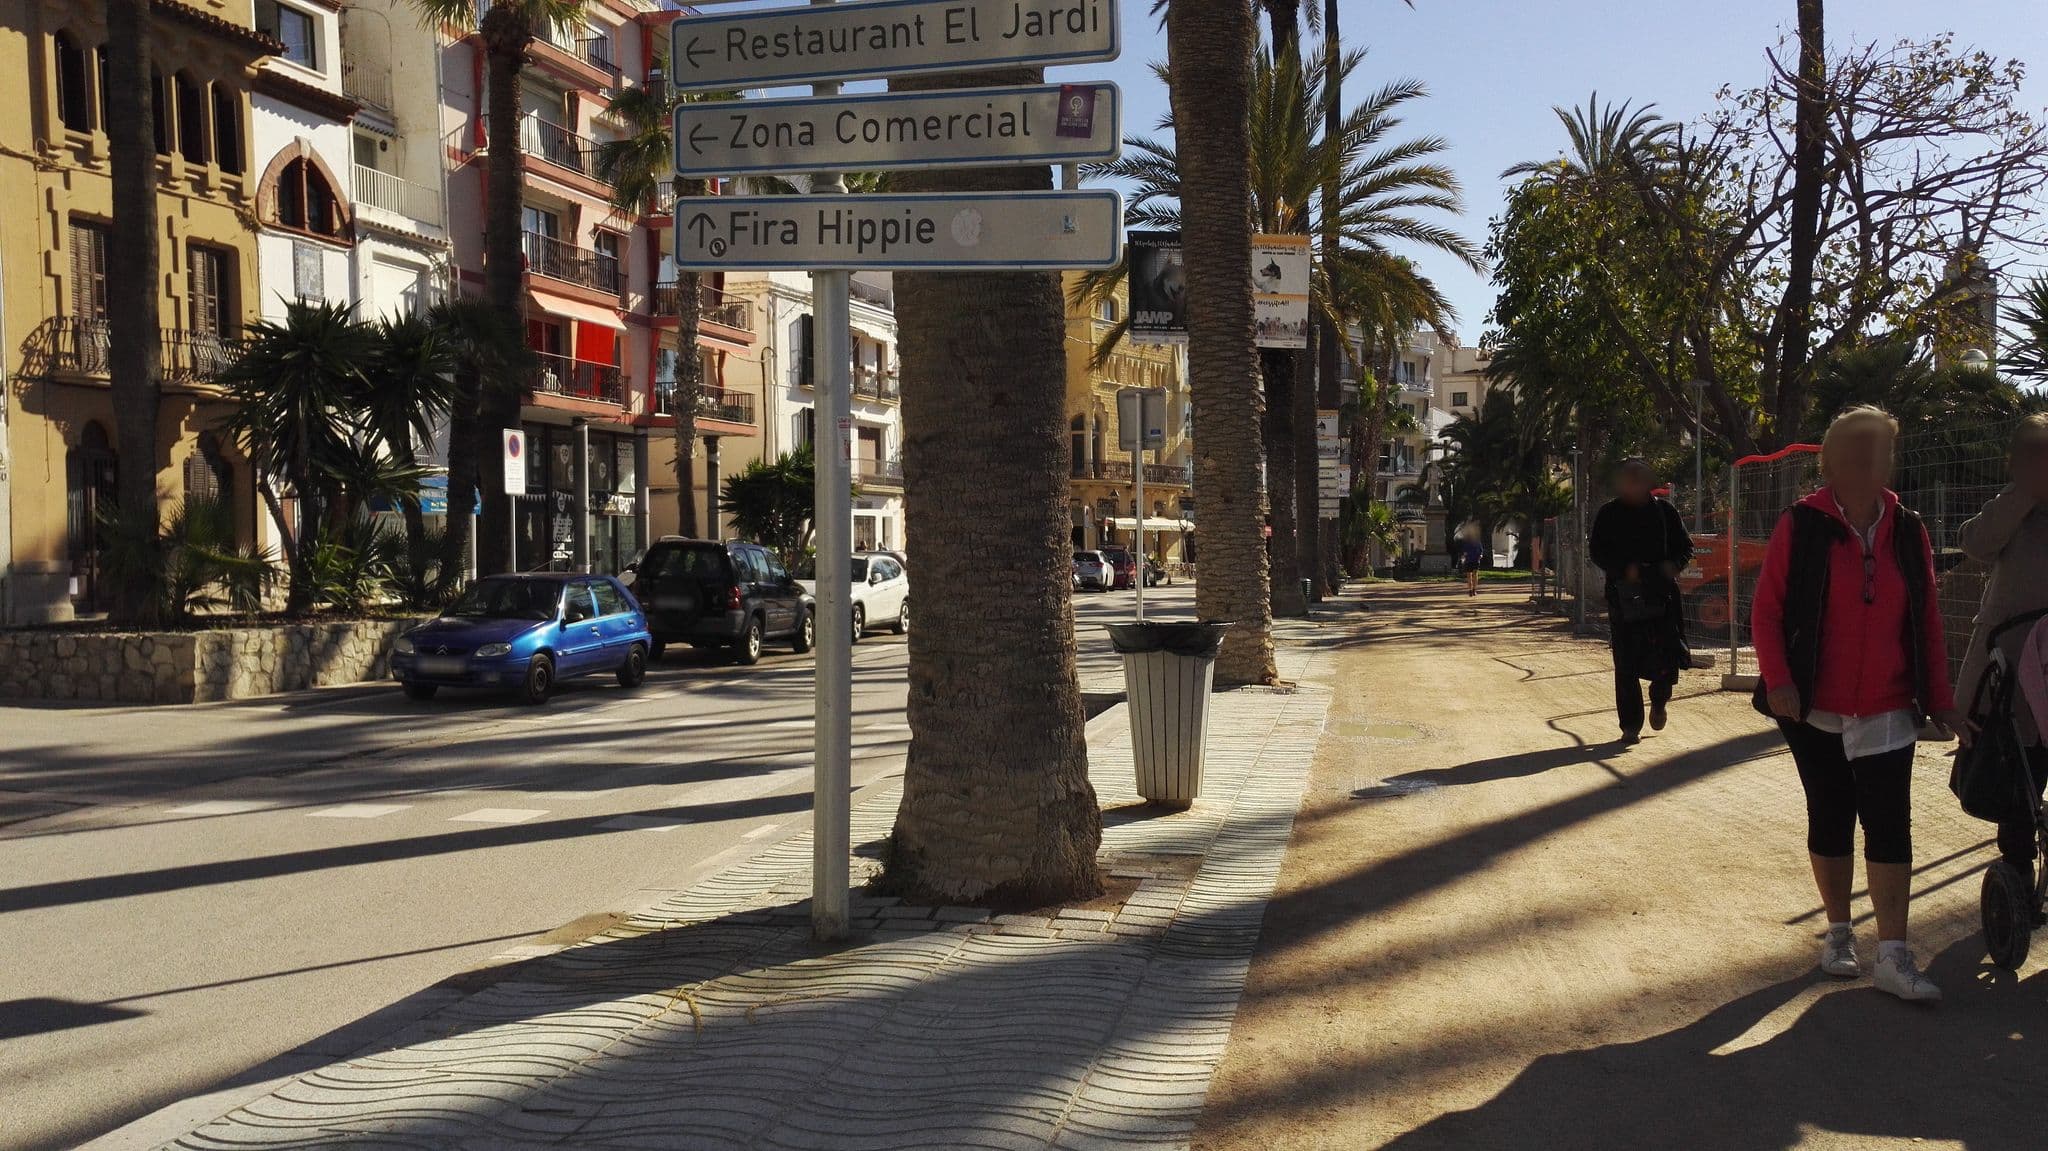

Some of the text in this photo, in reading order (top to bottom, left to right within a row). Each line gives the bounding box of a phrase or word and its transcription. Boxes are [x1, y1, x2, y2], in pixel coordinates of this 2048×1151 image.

[726, 14, 925, 63] Restaurant
[945, 7, 980, 44] El
[729, 101, 1031, 150] Zona Comercial
[729, 208, 936, 254] Fira Hippie
